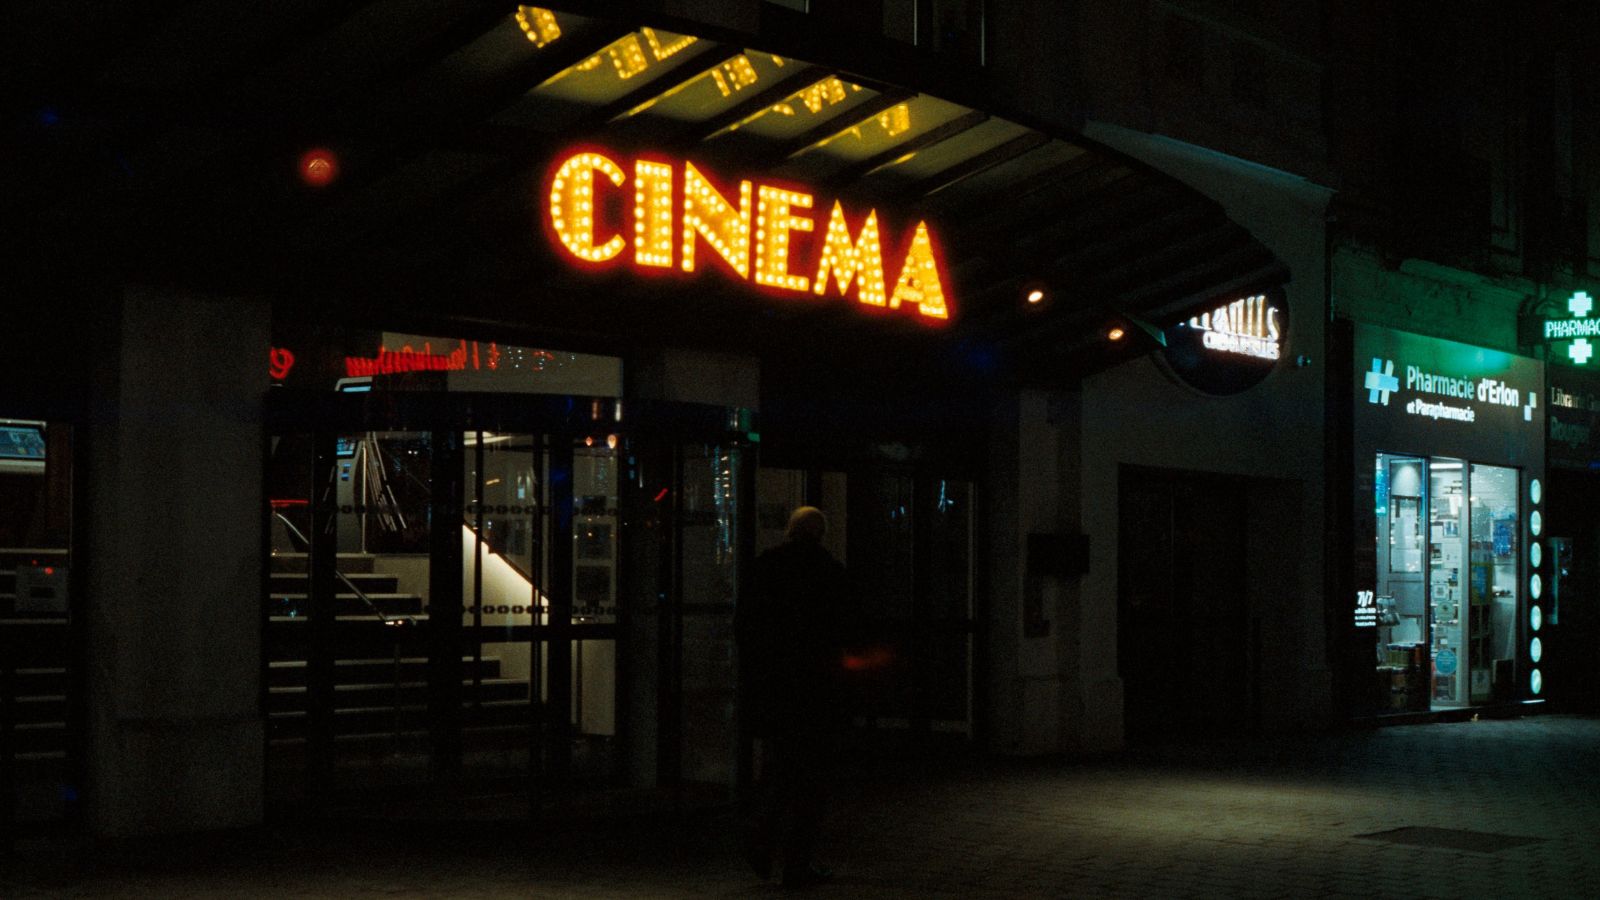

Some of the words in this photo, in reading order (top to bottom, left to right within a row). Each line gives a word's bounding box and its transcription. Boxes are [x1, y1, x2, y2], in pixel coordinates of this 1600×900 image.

[549, 151, 950, 321] CINEMA
[1406, 365, 1475, 400] Pharmacie
[1477, 377, 1519, 408] d'Erlon
[1416, 398, 1475, 423] Parapharmacie
